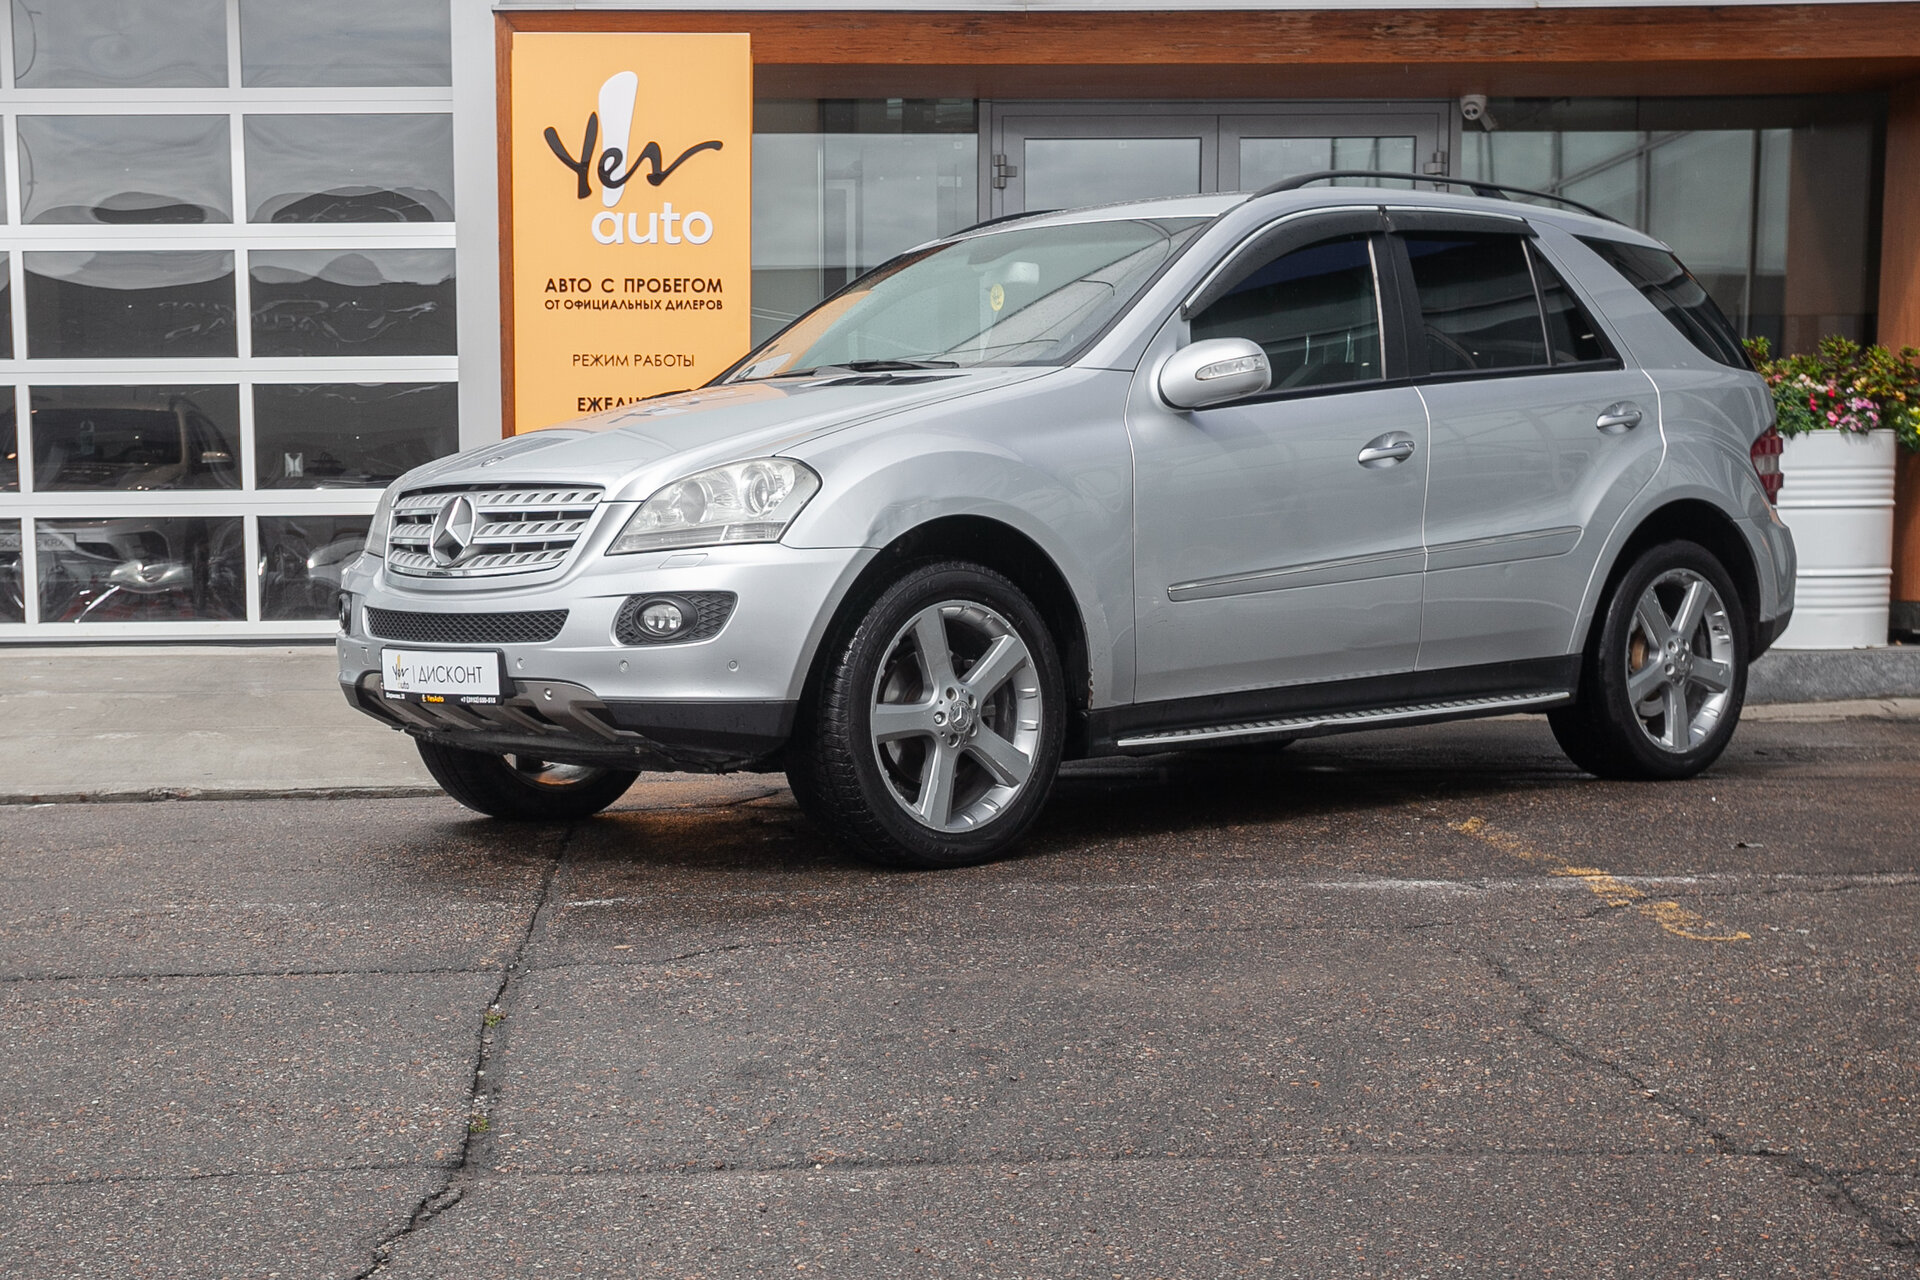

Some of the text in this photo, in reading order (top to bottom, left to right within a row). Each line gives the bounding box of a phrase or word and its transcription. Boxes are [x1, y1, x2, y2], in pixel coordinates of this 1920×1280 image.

[591, 202, 714, 245] auto
[544, 278, 723, 293] АВТО С ПРОБЕГОМ
[544, 299, 723, 311] ОТ ОФИЦИАЛЬНЫХ ДИЛЕРОВ
[572, 354, 695, 367] РЕЖИМ РАБОТЫ
[418, 665, 482, 684] ДИСКОНТ
